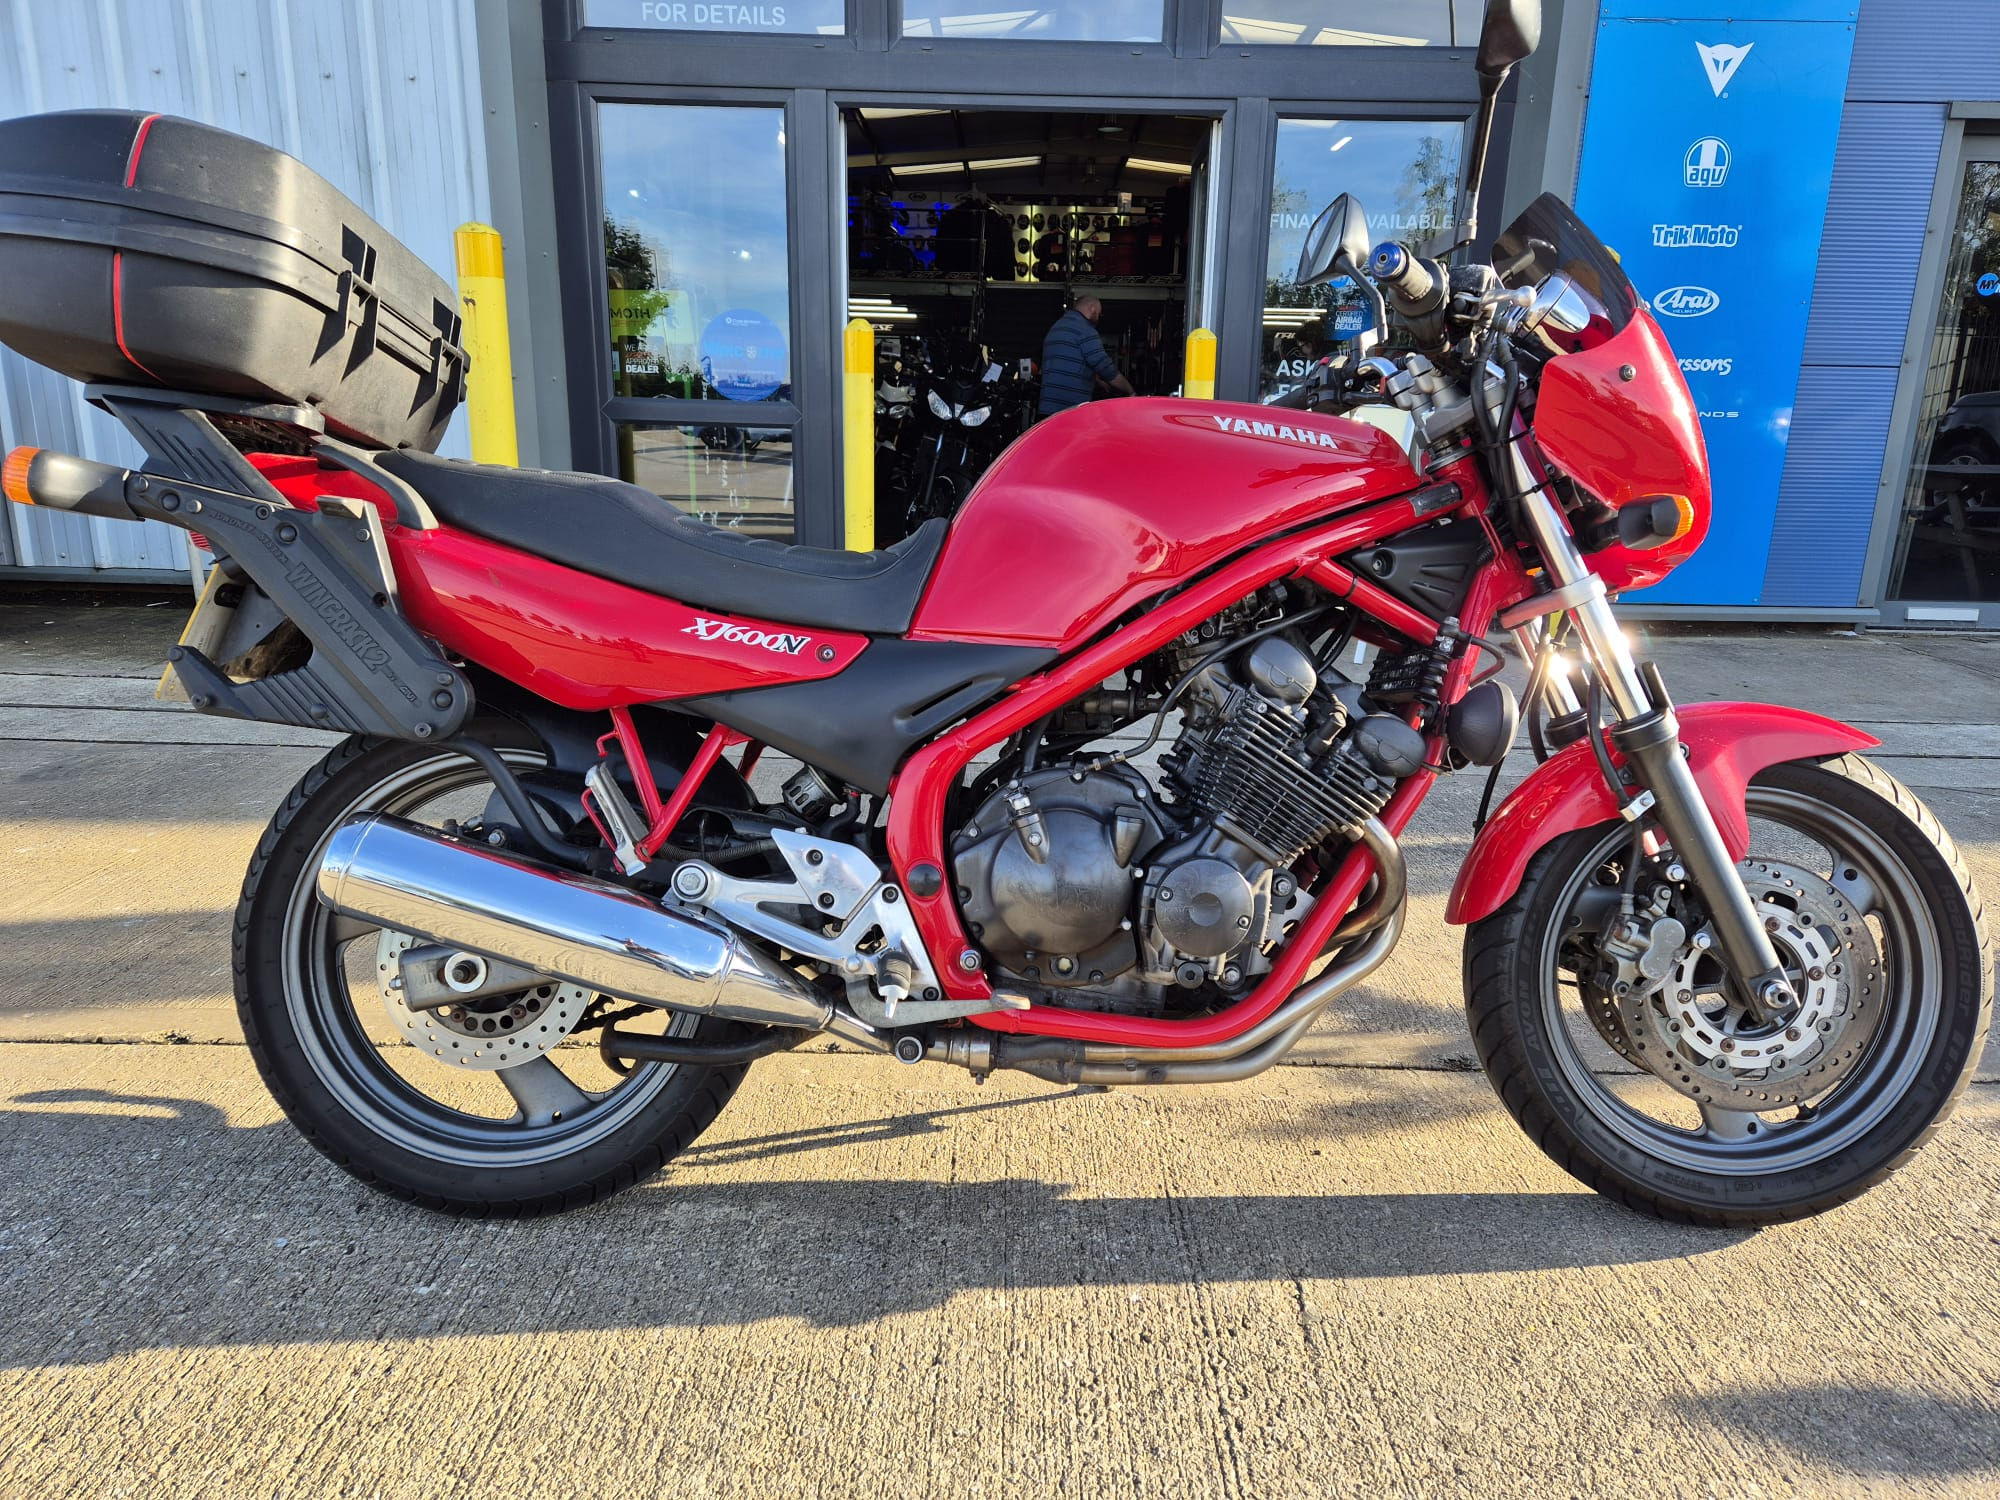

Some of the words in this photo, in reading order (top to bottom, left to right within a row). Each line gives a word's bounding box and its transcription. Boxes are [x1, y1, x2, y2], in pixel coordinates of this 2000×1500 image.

[641, 2, 687, 23] FOR
[694, 4, 786, 26] DETAILS
[1689, 167, 1724, 187] agv
[1270, 213, 1313, 230] FINA
[1365, 213, 1454, 230] VAILABLE
[1653, 224, 1691, 247] Trik
[1691, 224, 1739, 247] Moto
[1661, 288, 1713, 309] Arai
[611, 308, 651, 318] MOTH
[1336, 316, 1363, 324] AIRBAG
[1335, 323, 1362, 331] DEALER
[625, 364, 660, 374] DEALER
[1275, 358, 1320, 377] ASK
[1678, 358, 1733, 376] rssons
[1213, 415, 1338, 449] YAMAHA
[680, 617, 811, 656] XJ600N
[1518, 980, 1541, 1050] AVON
